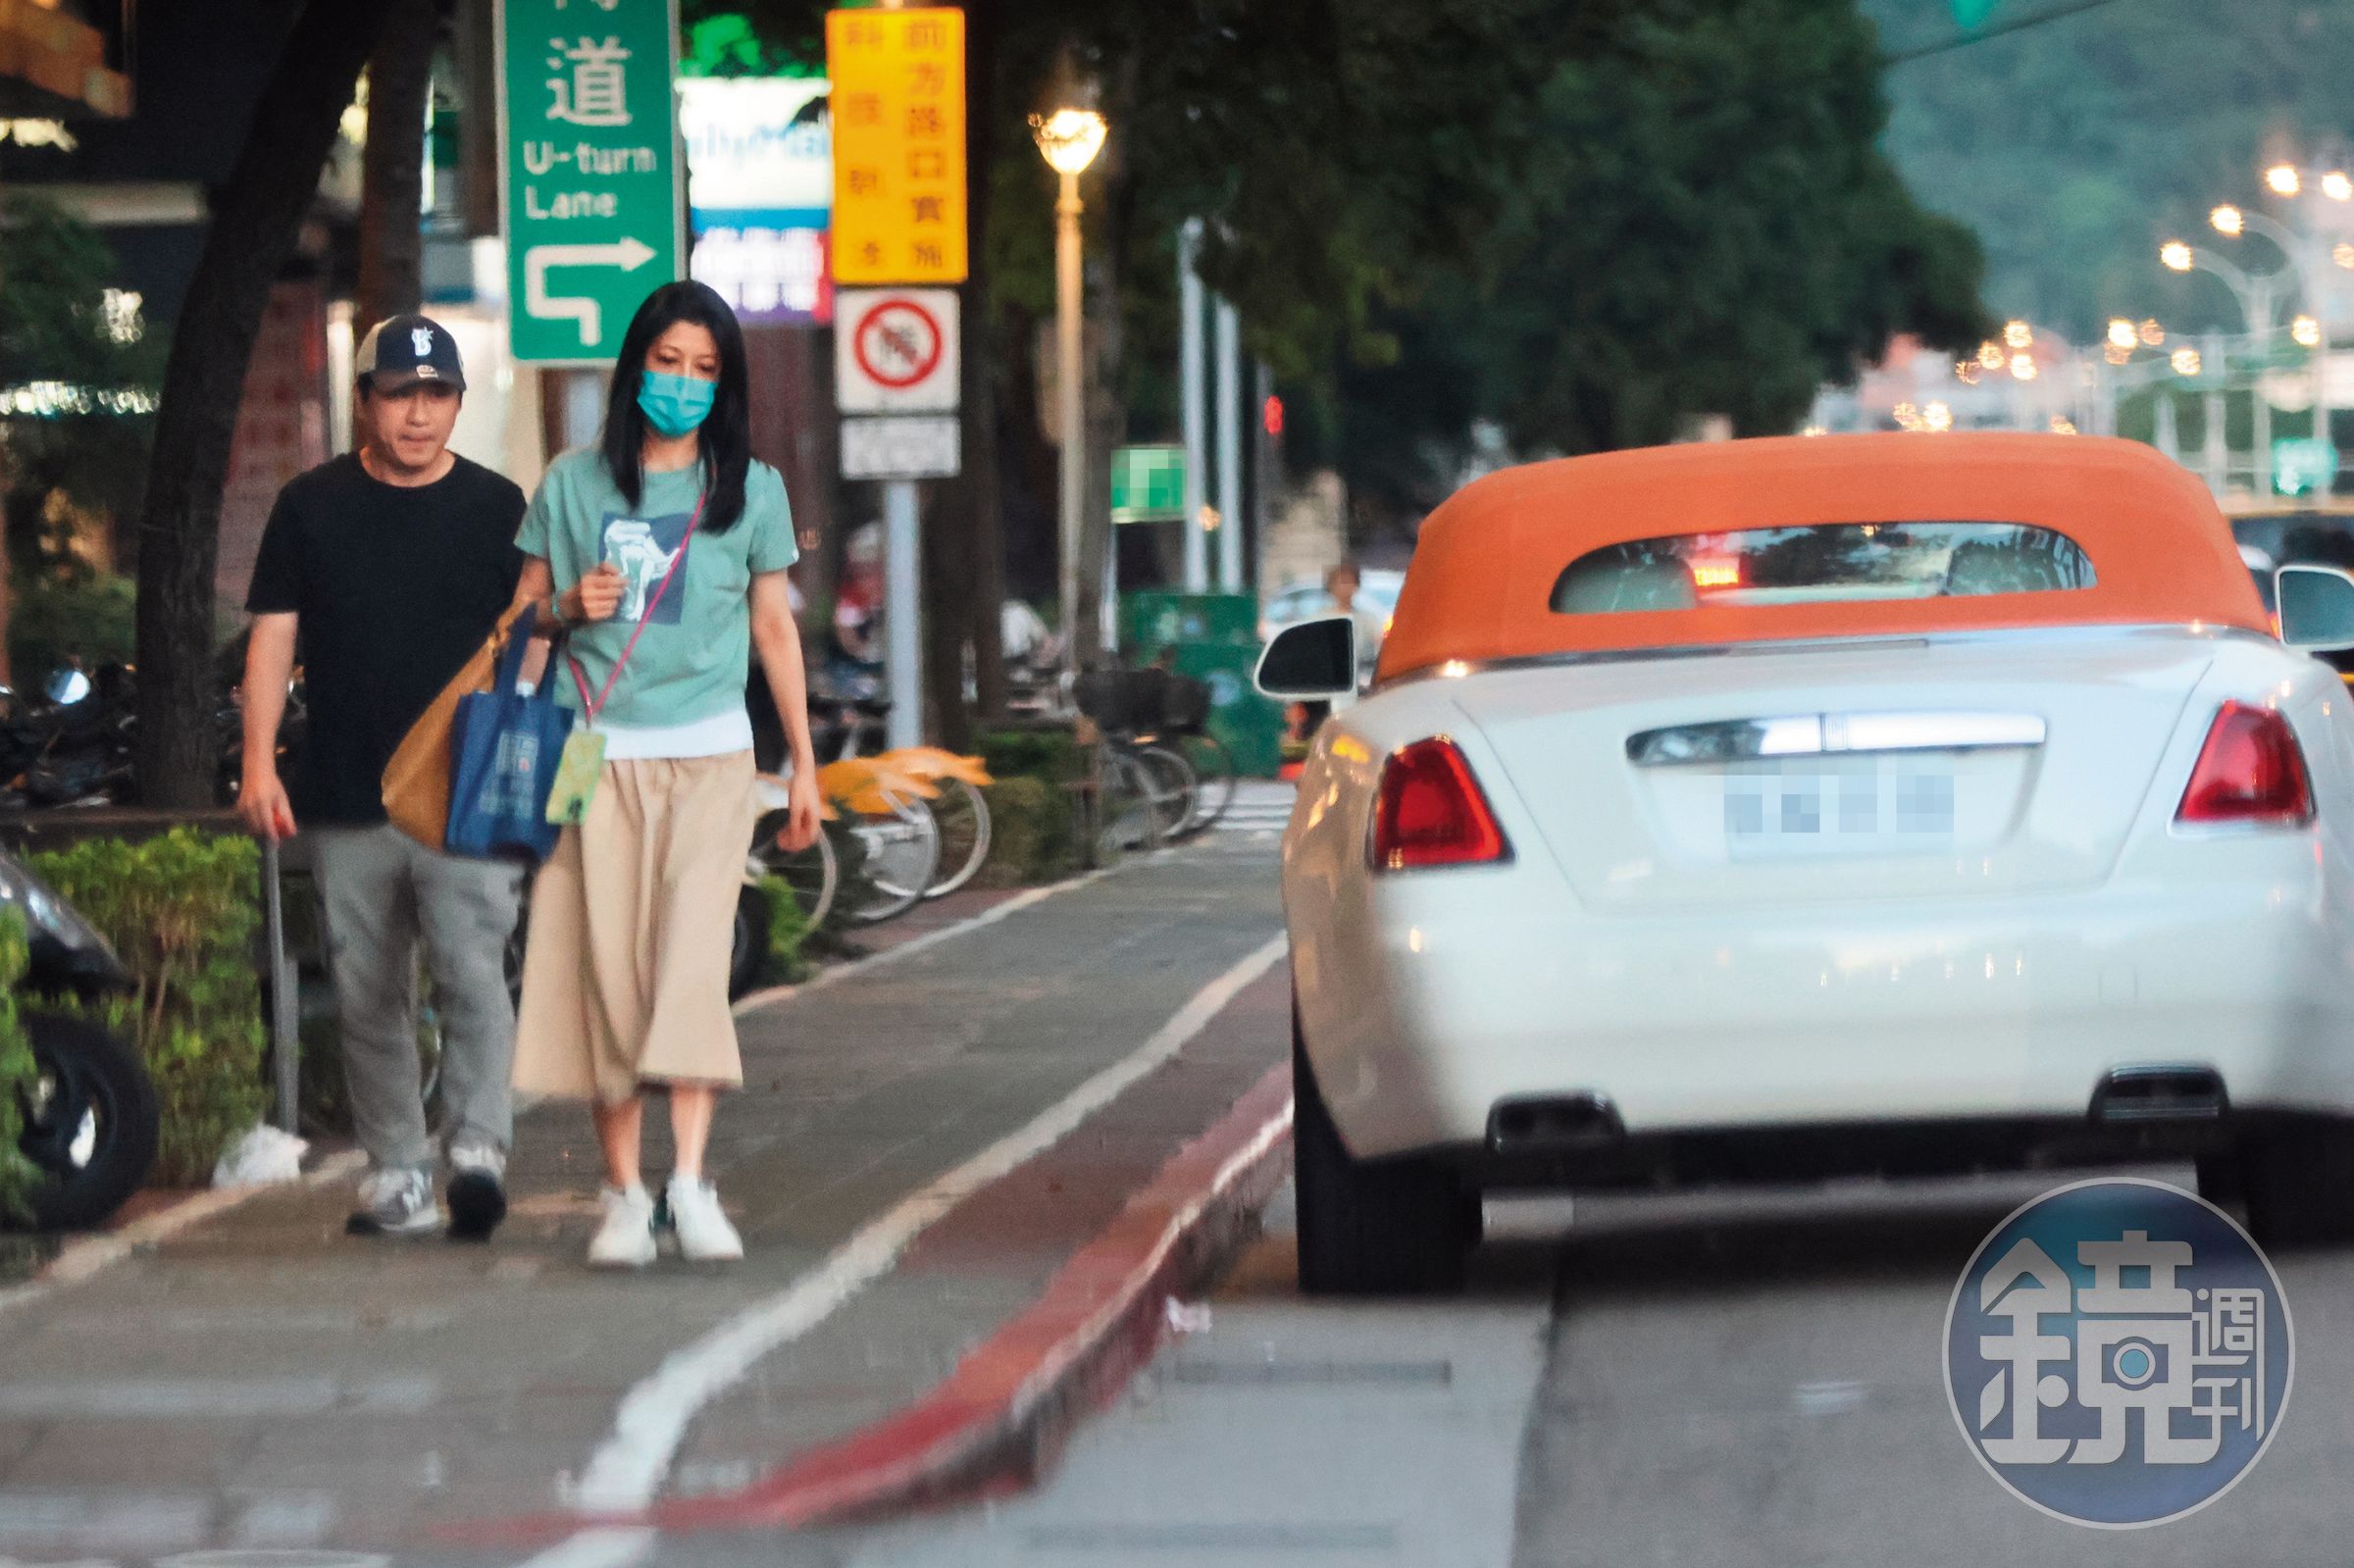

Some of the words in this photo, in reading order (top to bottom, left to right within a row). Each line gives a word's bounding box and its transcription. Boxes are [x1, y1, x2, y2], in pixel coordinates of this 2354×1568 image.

[545, 0, 633, 126] 道
[524, 140, 657, 176] U-turn
[525, 184, 618, 220] Lane
